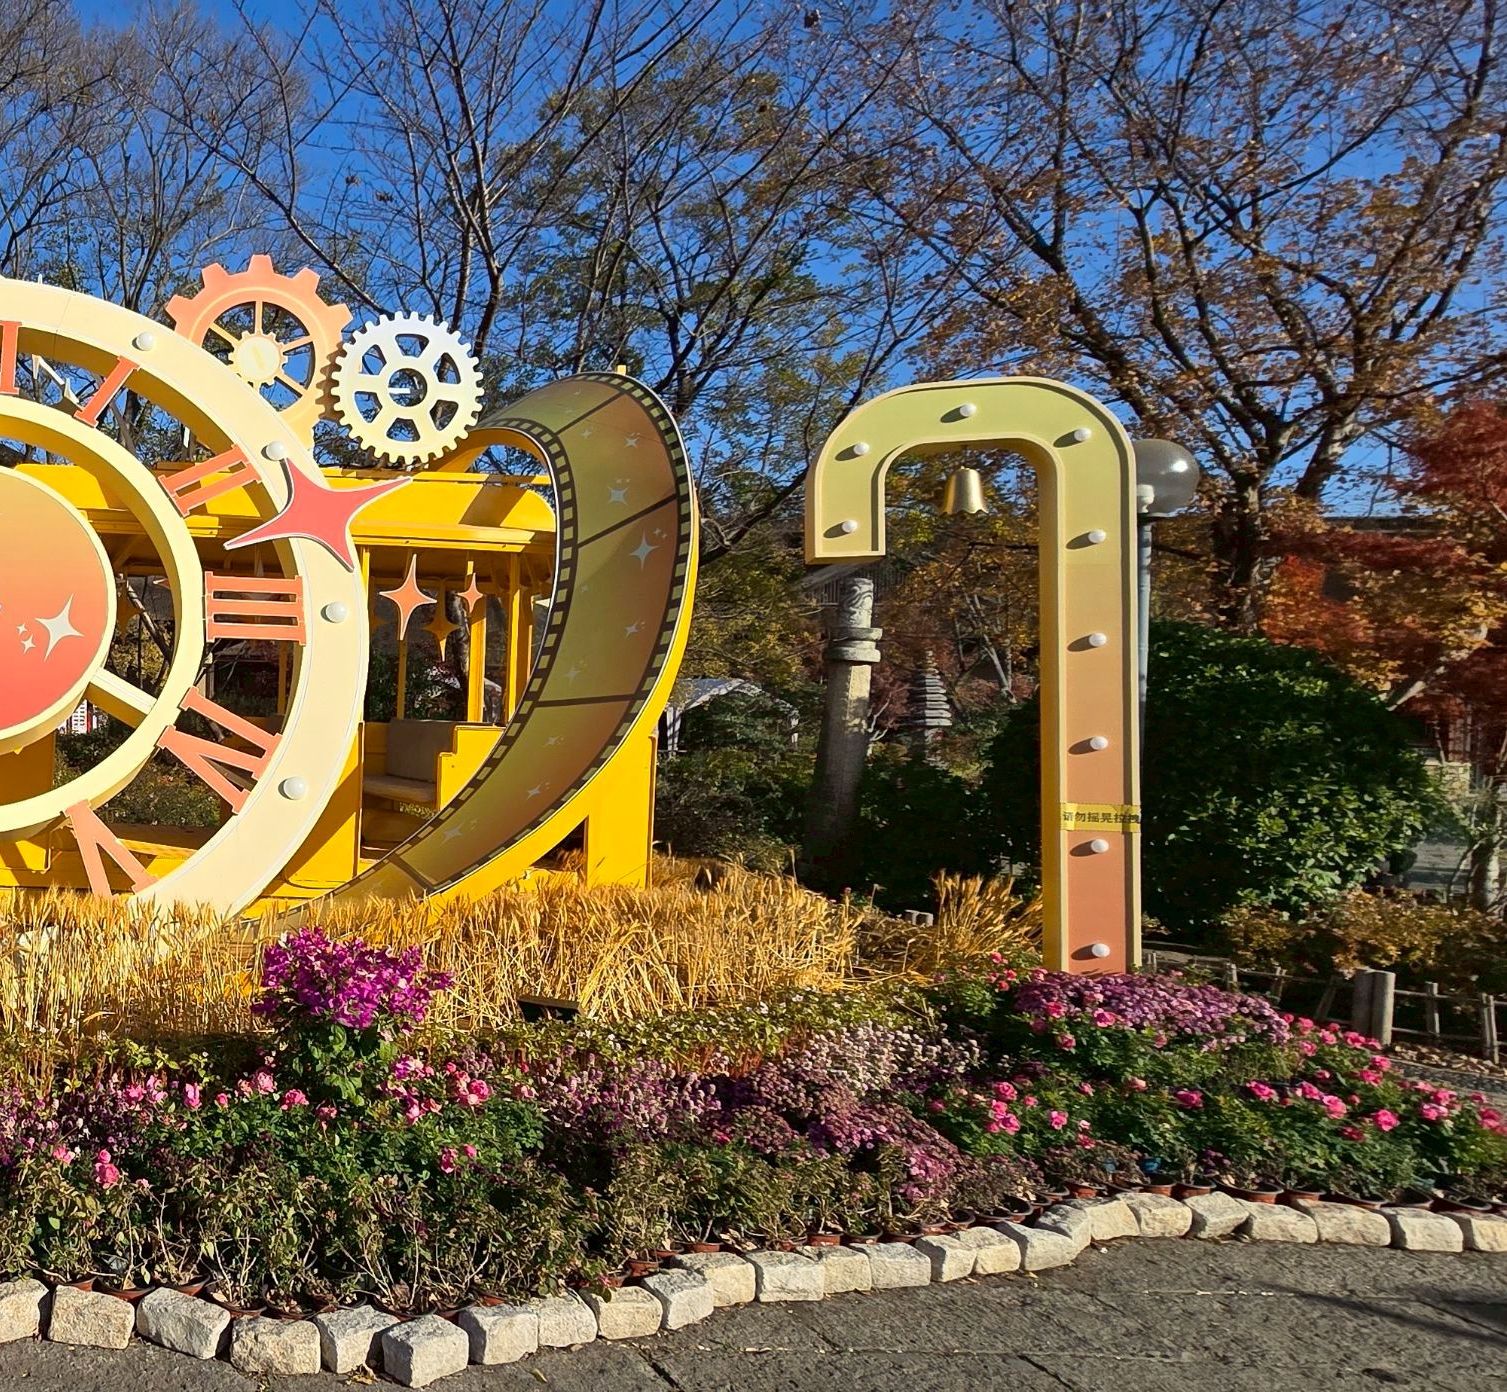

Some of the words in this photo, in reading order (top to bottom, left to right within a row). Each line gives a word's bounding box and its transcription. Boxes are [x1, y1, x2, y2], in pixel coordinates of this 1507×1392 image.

[74, 355, 141, 427] I
[158, 443, 263, 517] II
[203, 571, 307, 646] III
[64, 799, 159, 900] V
